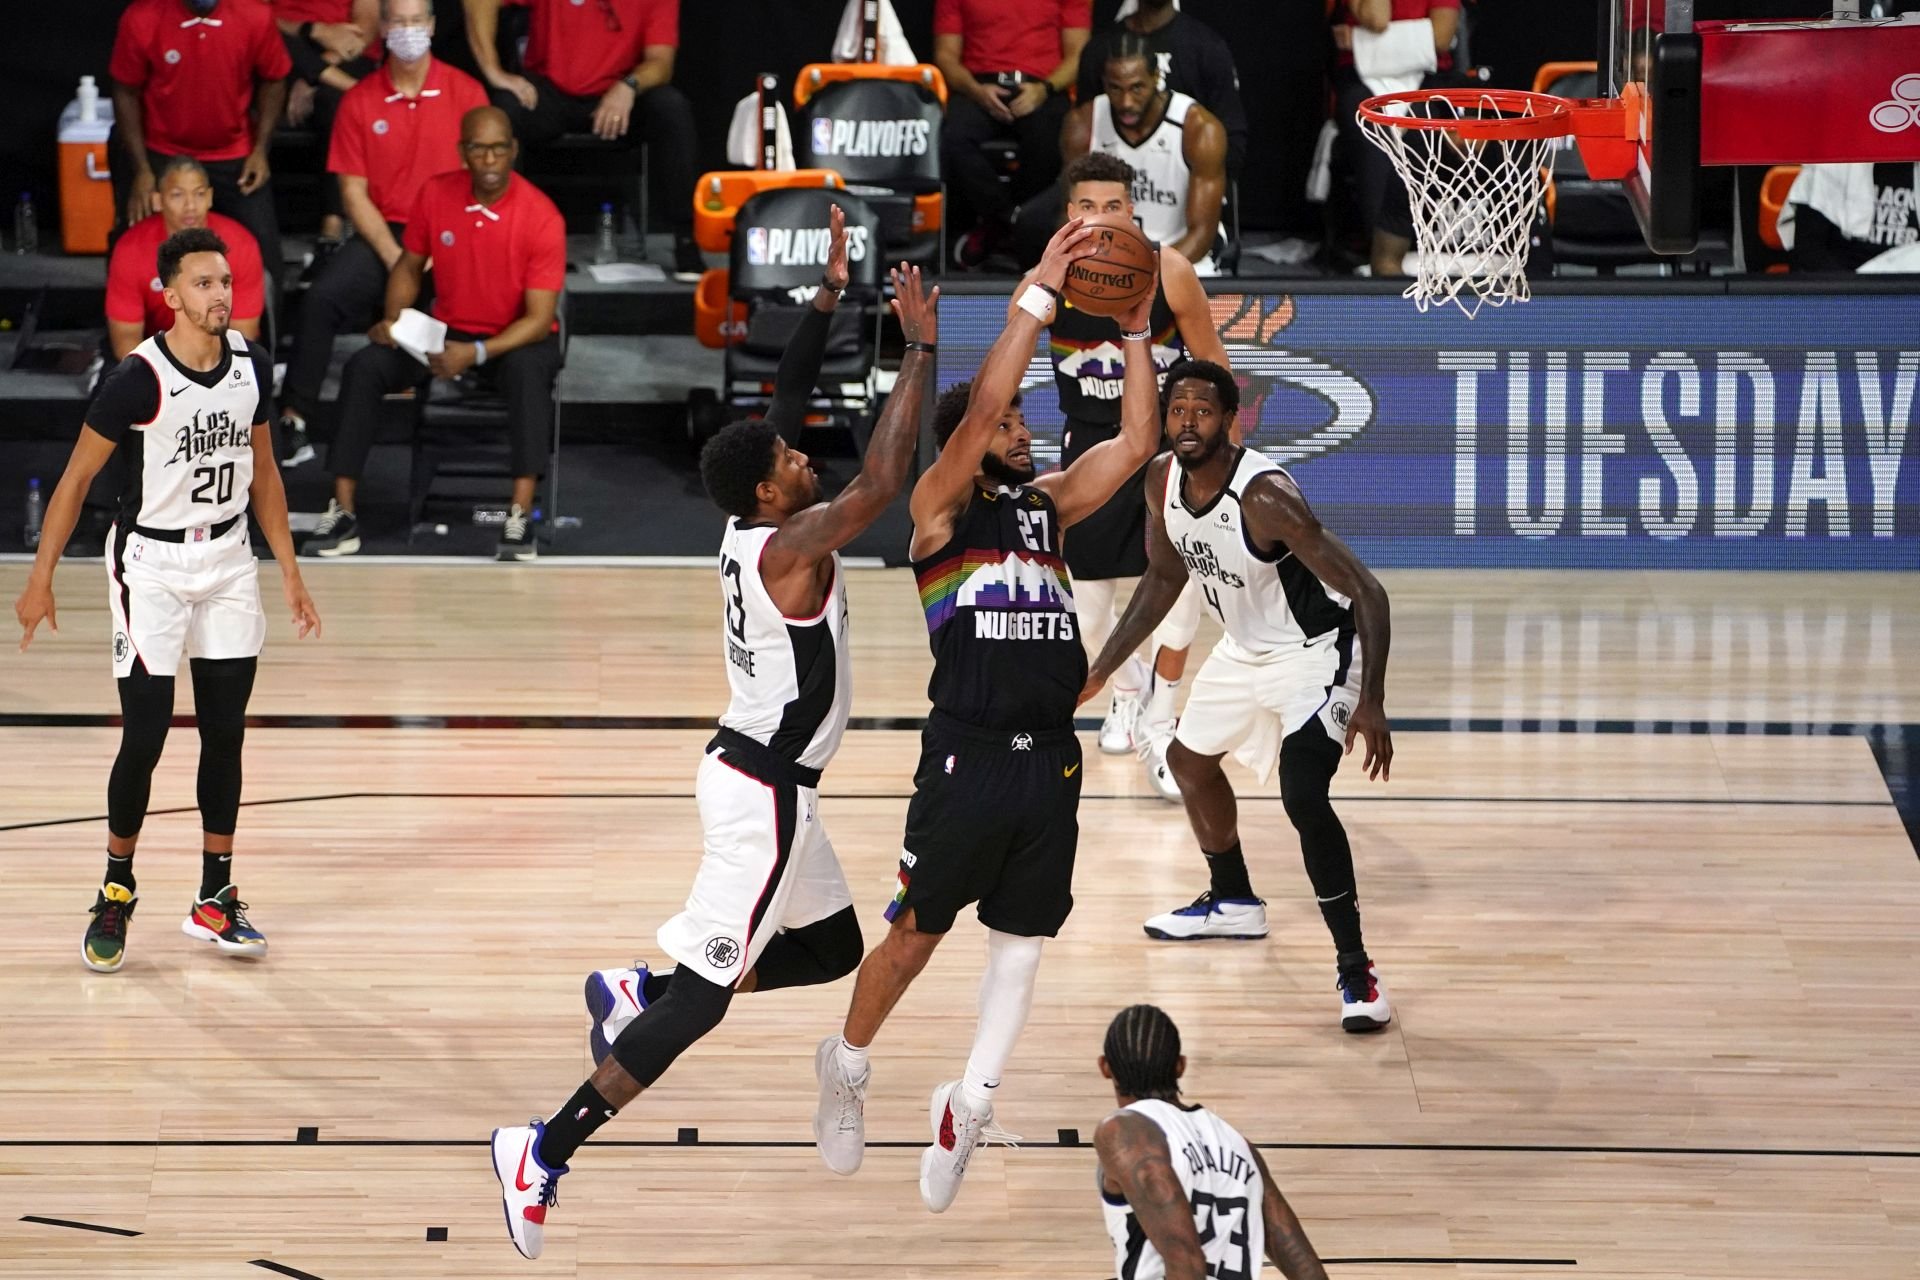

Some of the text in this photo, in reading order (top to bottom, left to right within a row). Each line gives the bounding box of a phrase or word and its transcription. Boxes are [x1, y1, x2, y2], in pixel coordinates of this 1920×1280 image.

[832, 119, 930, 157] PLAYOFFS
[767, 225, 868, 266] PLAYOFS
[228, 380, 250, 390] bumble
[190, 408, 230, 435] Los
[164, 419, 250, 467] Angeles
[1437, 351, 1920, 539] TUESDAY
[191, 461, 235, 505] 20
[1016, 508, 1051, 552] 27
[1181, 533, 1214, 560] Los
[1213, 521, 1237, 533] bumble
[1202, 583, 1226, 624] 4
[975, 611, 1074, 640] NUGGETS
[1191, 1188, 1252, 1280] 23
